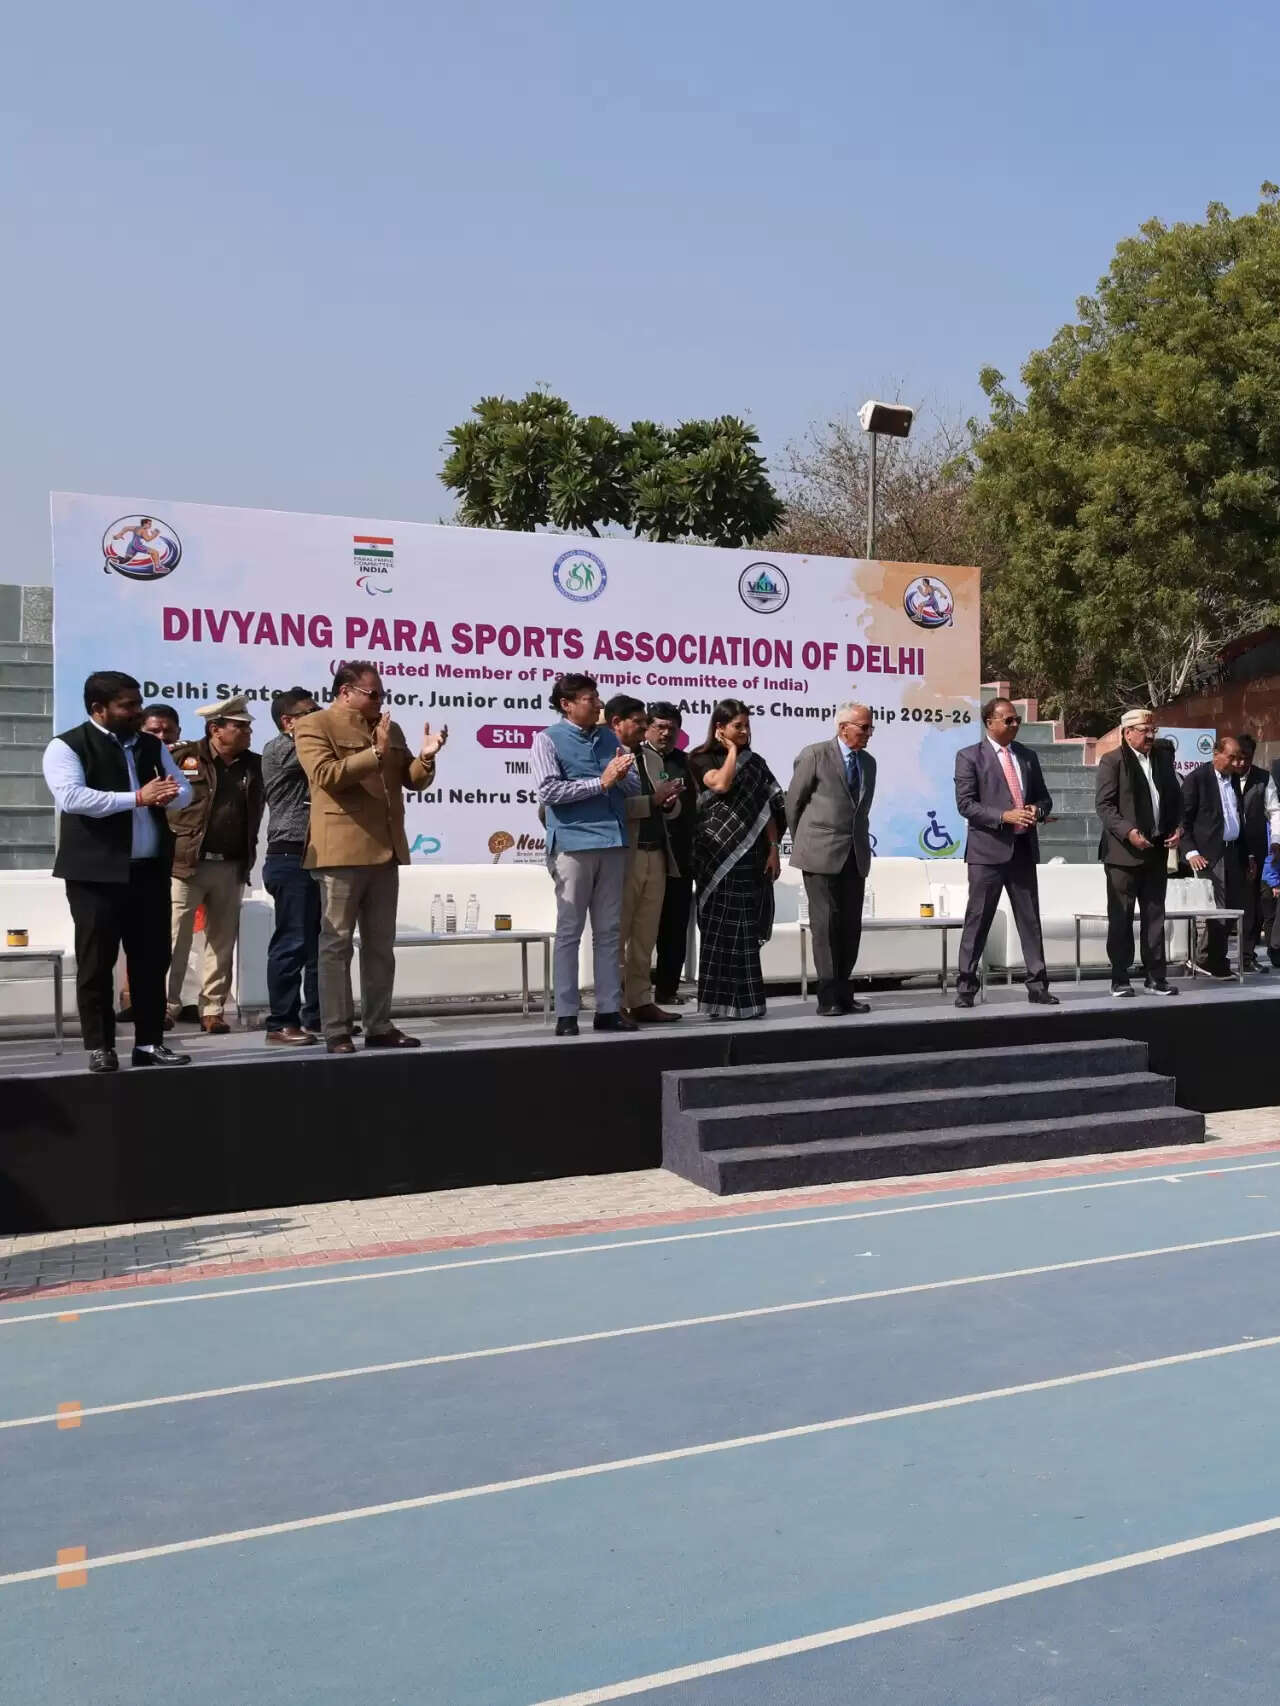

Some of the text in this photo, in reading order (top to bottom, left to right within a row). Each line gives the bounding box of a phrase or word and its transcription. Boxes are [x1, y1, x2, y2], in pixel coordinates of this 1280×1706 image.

[163, 607, 924, 675] DIVYANG PARA SPORTS ASSOCIATION OF DELHI
[435, 664, 512, 681] Member
[518, 667, 536, 681] of
[647, 673, 738, 689] Committee
[743, 677, 758, 689] of
[764, 678, 808, 693] India)
[144, 681, 208, 699] Delhi
[429, 690, 499, 709] Junior
[503, 694, 542, 710] and
[770, 702, 896, 724] Champihip
[901, 709, 971, 724] 2025-26
[492, 729, 525, 744] 5th
[450, 788, 511, 804] Nehru
